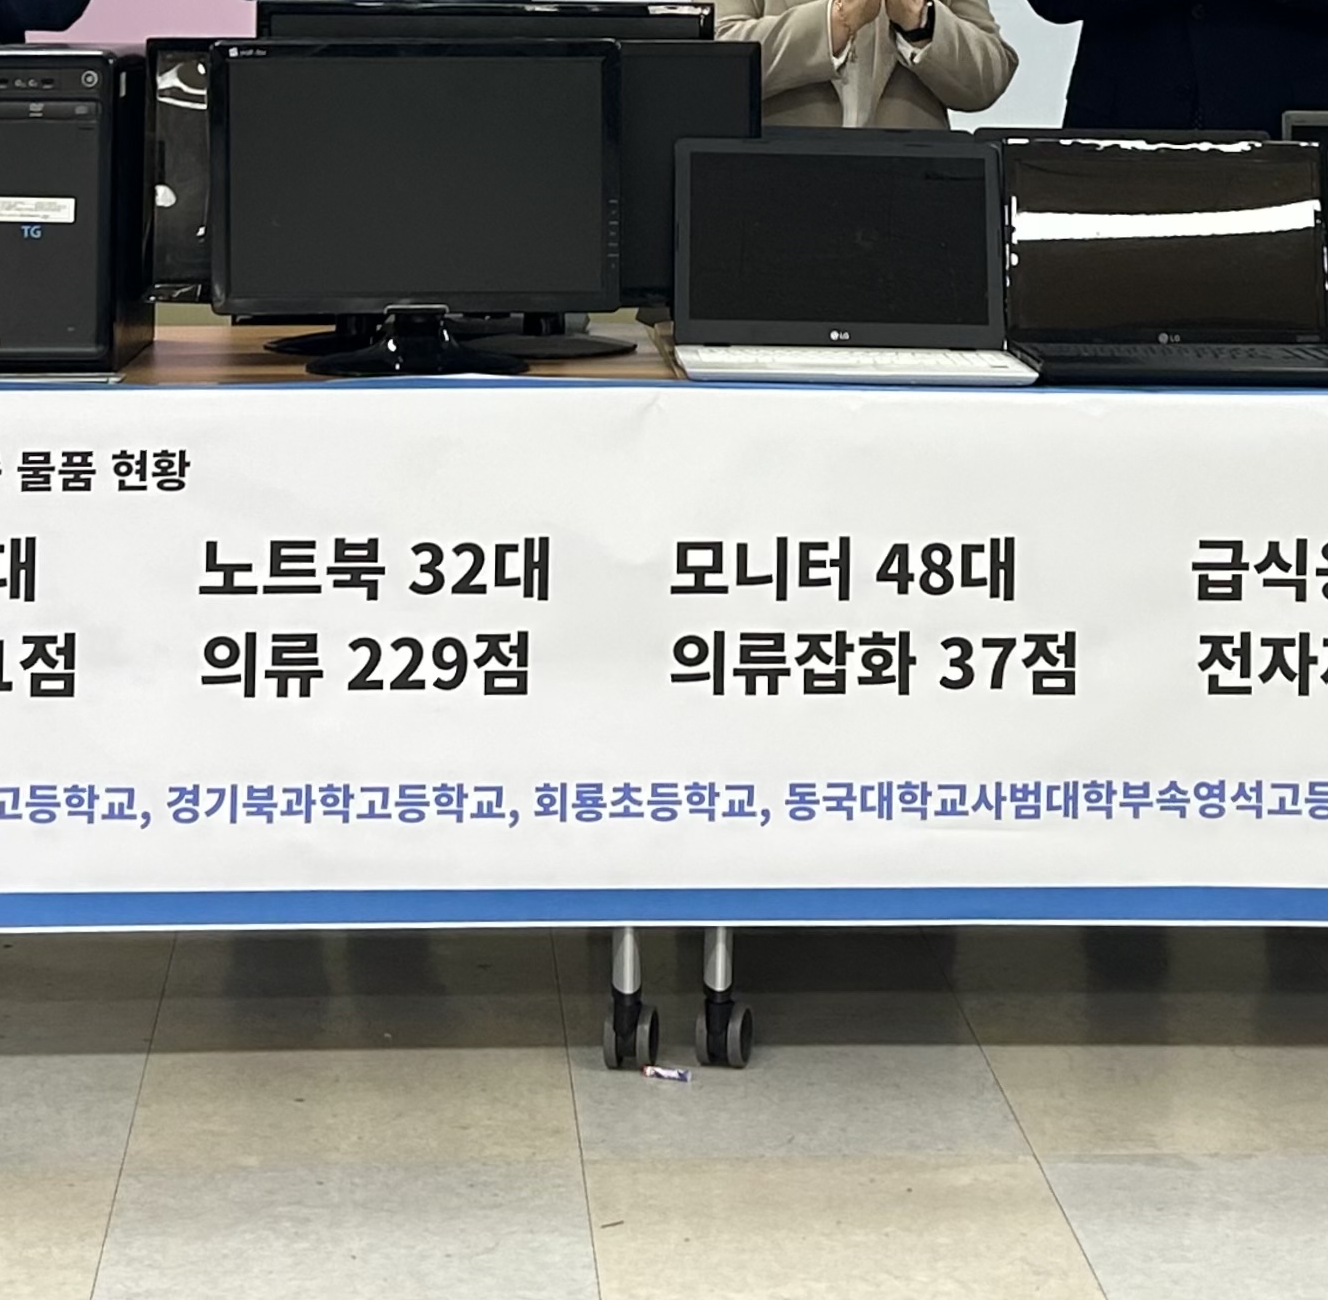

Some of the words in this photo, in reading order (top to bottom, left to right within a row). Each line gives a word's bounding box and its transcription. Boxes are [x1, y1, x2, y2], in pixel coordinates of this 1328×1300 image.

[20, 225, 42, 239] TG
[16, 450, 97, 493] 물품
[111, 449, 191, 492] 현황
[198, 537, 386, 602] 노트북
[408, 536, 550, 602] 32대
[670, 535, 851, 602] 모니터
[875, 536, 1016, 602] 48대
[200, 631, 324, 699] 의류
[347, 630, 529, 696] 229점
[670, 630, 917, 696] 의류잡화
[939, 630, 1077, 696] 37점
[166, 782, 520, 829] 경기북과학고등학교,
[533, 781, 771, 828] 회룡초등학교,
